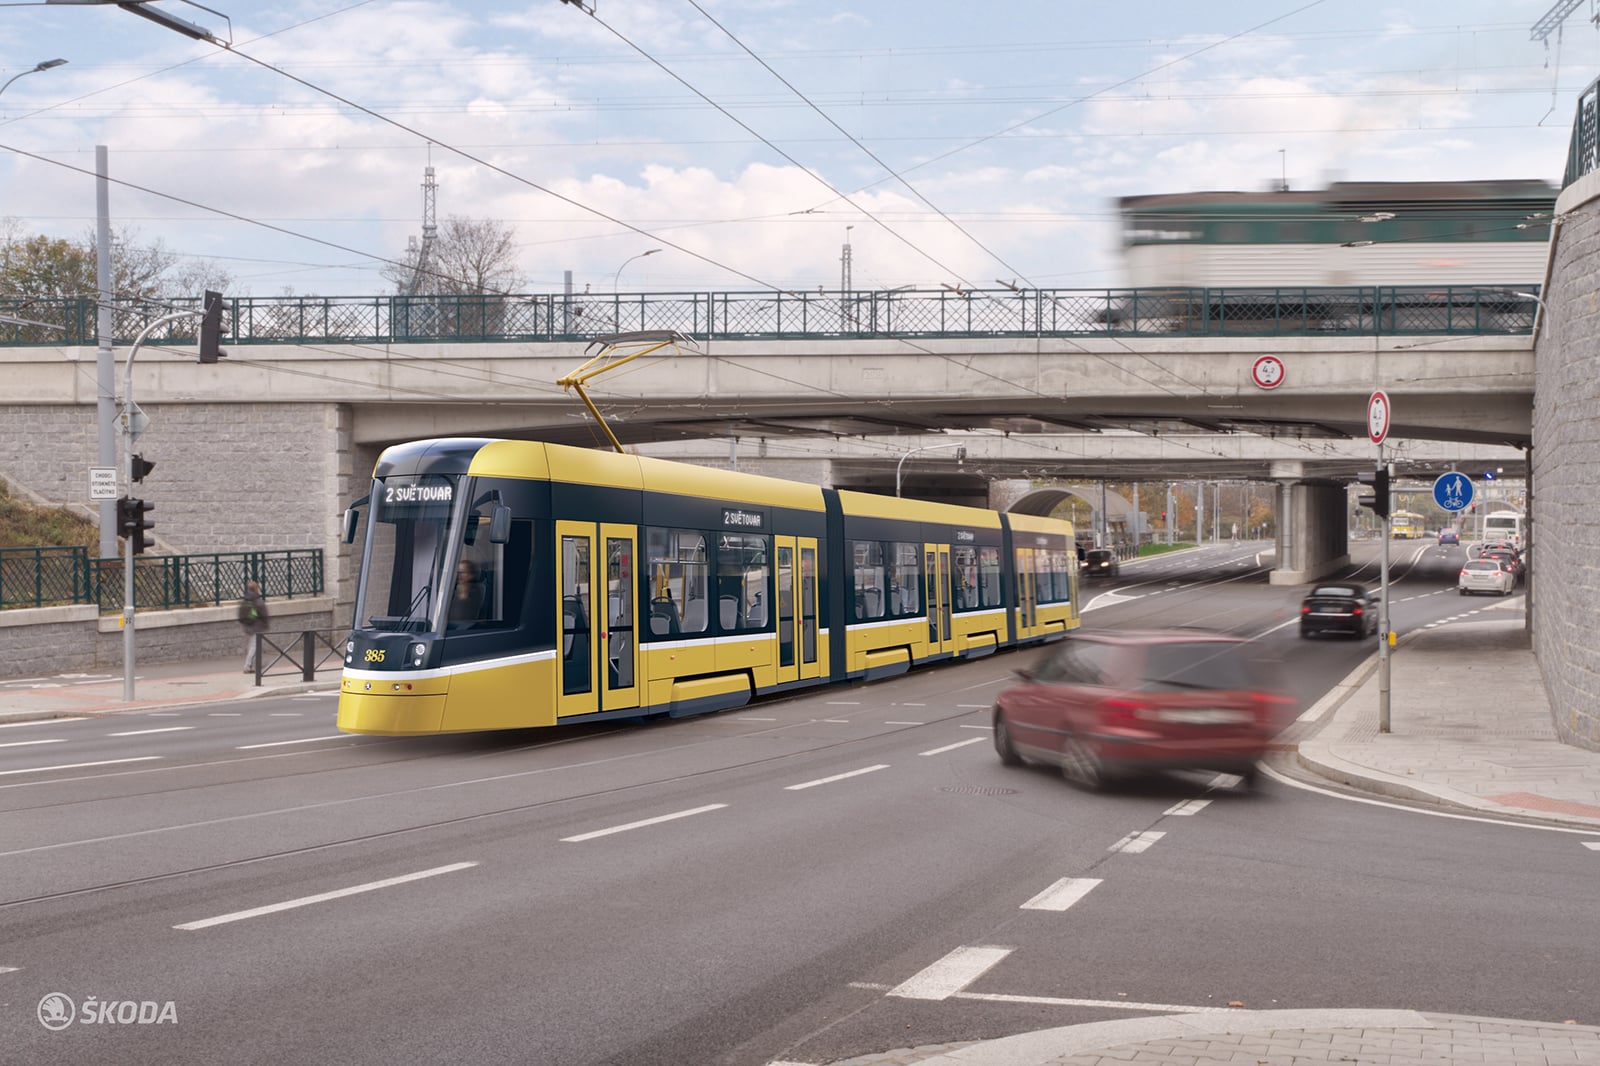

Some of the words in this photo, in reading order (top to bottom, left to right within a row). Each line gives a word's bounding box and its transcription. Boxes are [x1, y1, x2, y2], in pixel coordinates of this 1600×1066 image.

[385, 487, 394, 503] 2
[396, 483, 452, 501] SVĚTOVAR
[724, 511, 730, 525] 2
[730, 510, 761, 527] SVĚTOVAR
[364, 648, 386, 663] 385
